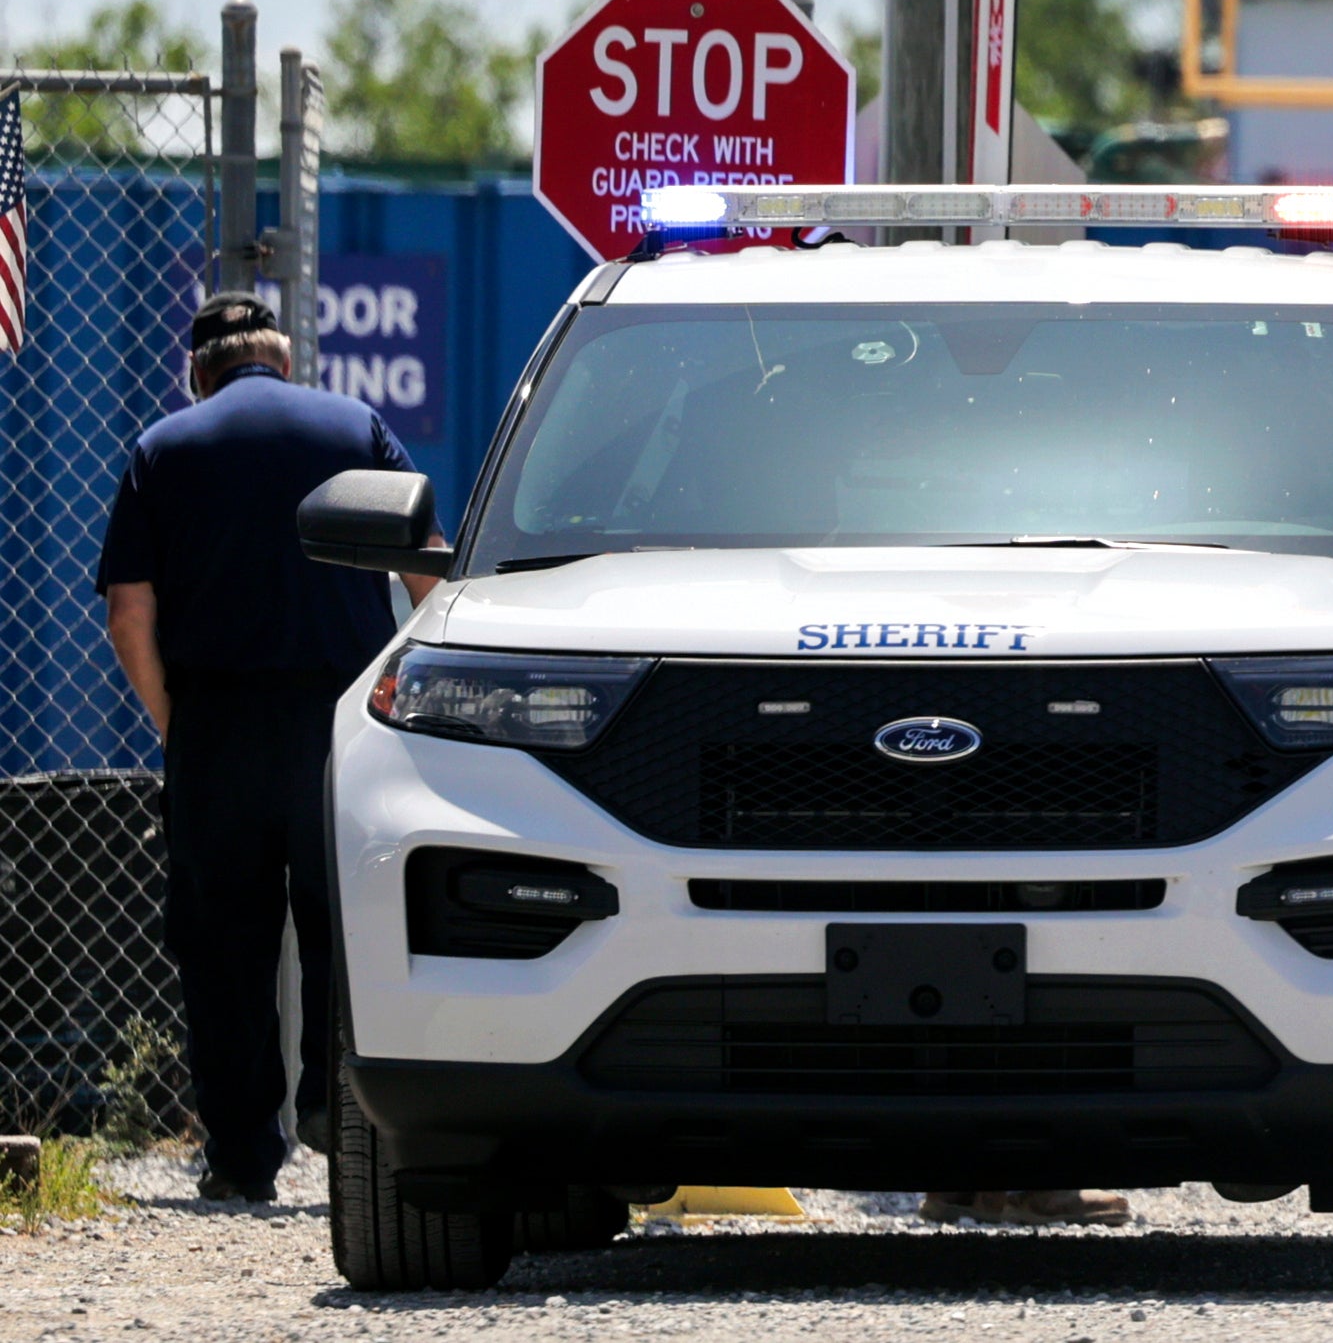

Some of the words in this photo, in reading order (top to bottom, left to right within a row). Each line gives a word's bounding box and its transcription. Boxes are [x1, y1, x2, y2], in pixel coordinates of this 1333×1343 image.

[589, 24, 804, 121] STOP
[614, 131, 700, 163] CHECK
[713, 134, 774, 166] WITH
[899, 728, 955, 752] Ford
